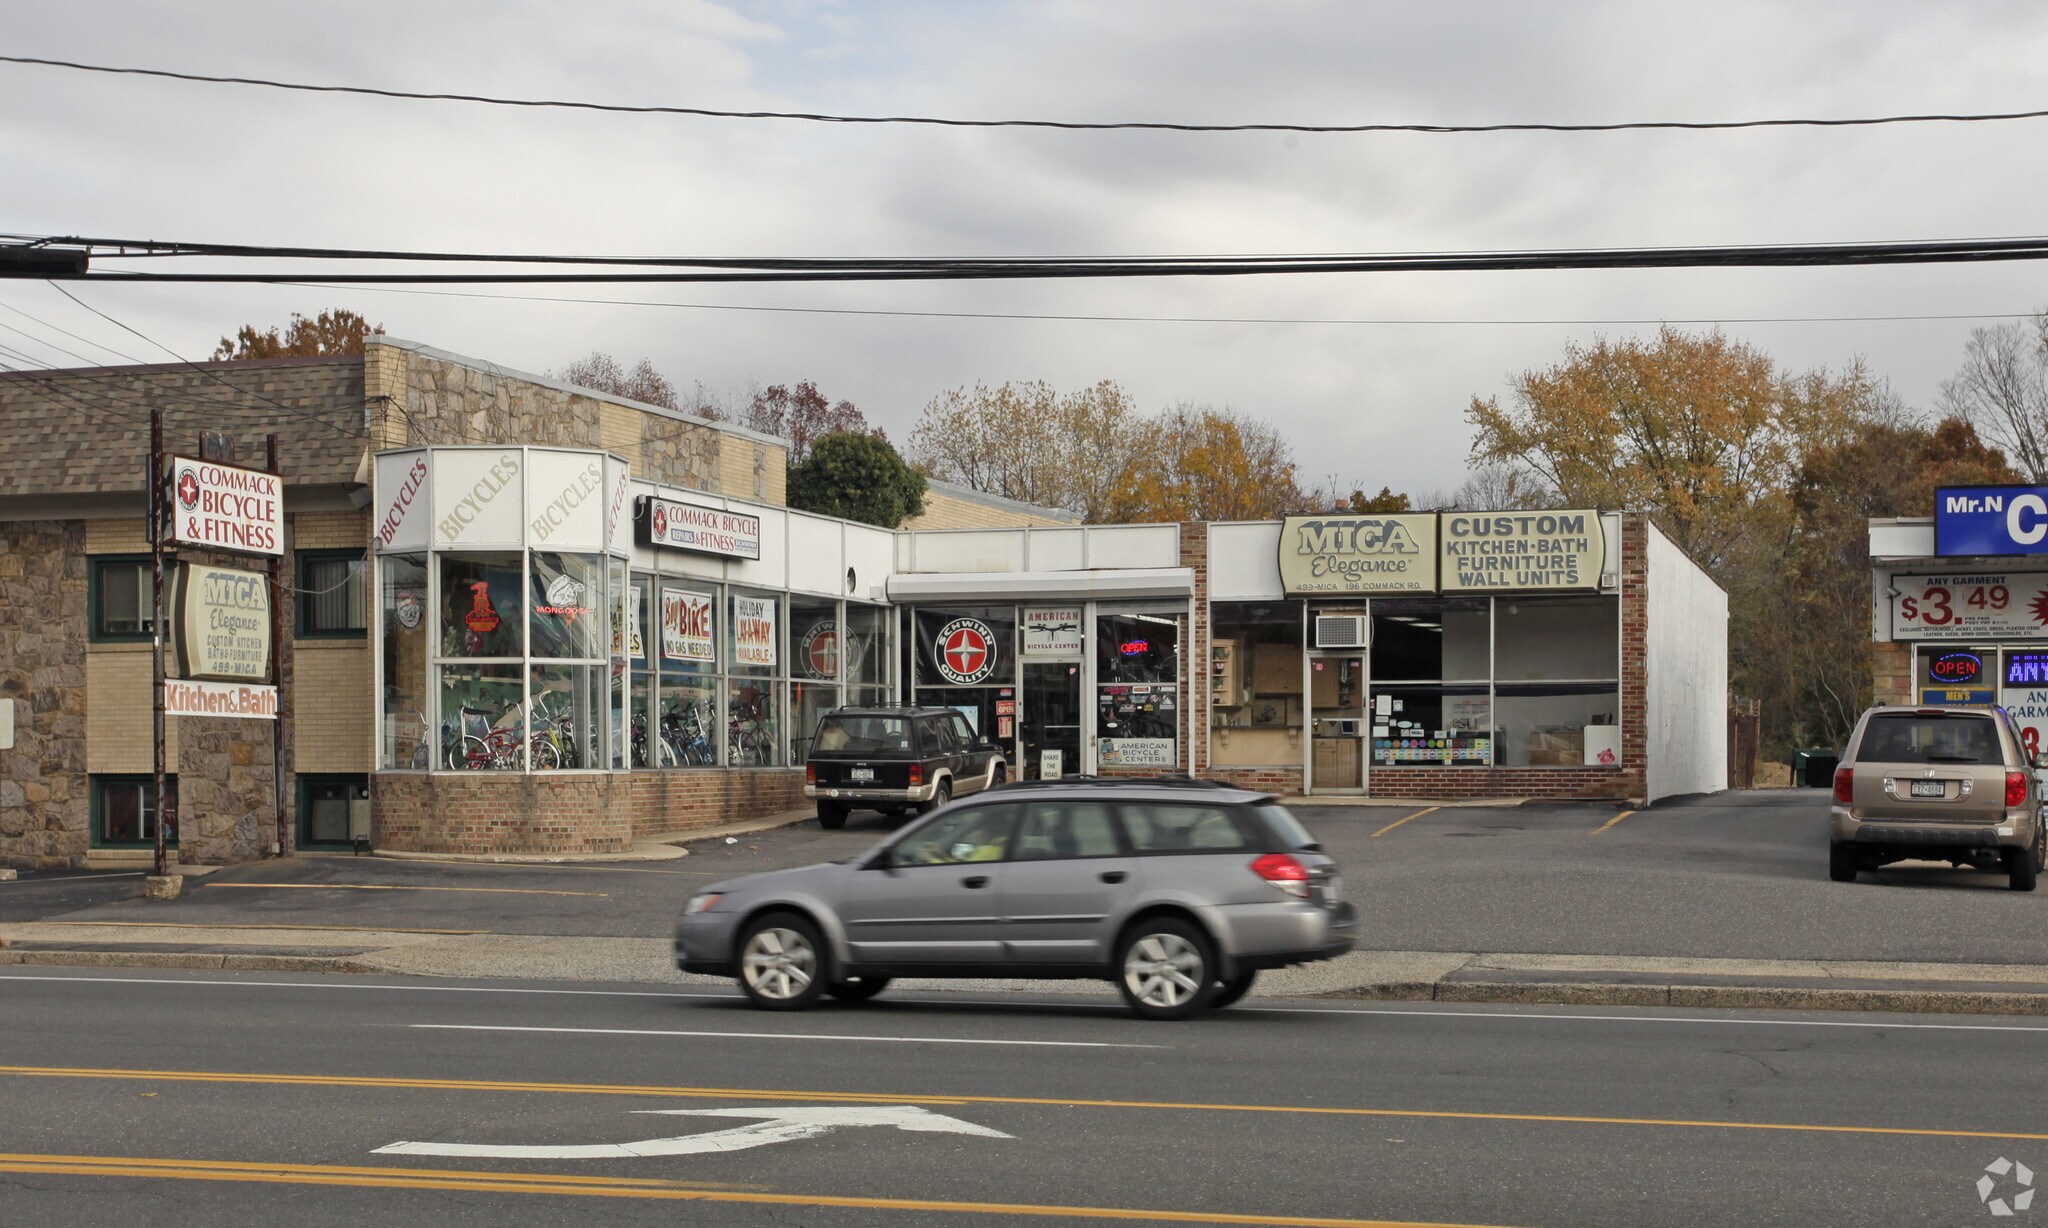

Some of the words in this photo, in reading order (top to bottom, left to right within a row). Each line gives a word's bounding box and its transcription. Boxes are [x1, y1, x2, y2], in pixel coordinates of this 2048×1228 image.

[199, 466, 275, 496] COMMACK
[202, 489, 276, 523] BICYCLE
[380, 457, 427, 545] BICYCLES
[438, 454, 519, 542] BICYCLES
[530, 462, 603, 542] BICYCLES
[1946, 496, 2003, 513] Mr.N
[669, 506, 718, 530] COMMACK
[722, 515, 757, 536] BICYCLE
[1450, 515, 1585, 537] CUSTOM
[2006, 494, 2048, 545] C
[186, 516, 201, 540] &
[204, 517, 275, 550] FITNESS
[672, 530, 694, 543] REPAIRS
[1298, 520, 1420, 555] MICA
[1311, 555, 1408, 582] Elegance
[1457, 554, 1578, 571] FURNITURE
[1363, 582, 1406, 590] COMMACK
[1458, 571, 1511, 586] WALL
[1516, 570, 1579, 585] UNITS
[1927, 577, 1949, 585] ANY
[1953, 576, 2006, 584] GARMENT
[205, 572, 266, 611] MICA
[691, 598, 699, 608] A
[739, 600, 764, 618] HOLIDAY
[210, 608, 258, 635] Elegance
[680, 596, 710, 638] BIKE
[1028, 611, 1079, 621] AMERICAN
[207, 635, 233, 647] CUSTOM
[237, 637, 262, 649] KITCHEN
[938, 620, 993, 646] SCHWINN
[666, 640, 675, 653] NO
[675, 641, 687, 654] GAS
[687, 642, 712, 656] NEEDED
[739, 648, 770, 661] AVAILABLE
[1121, 642, 1149, 653] OPEN
[941, 664, 989, 683] QUALITY
[1935, 661, 1977, 674] OPEN
[1945, 691, 1971, 701] MEN'S
[1120, 742, 1168, 750] AMERICAN
